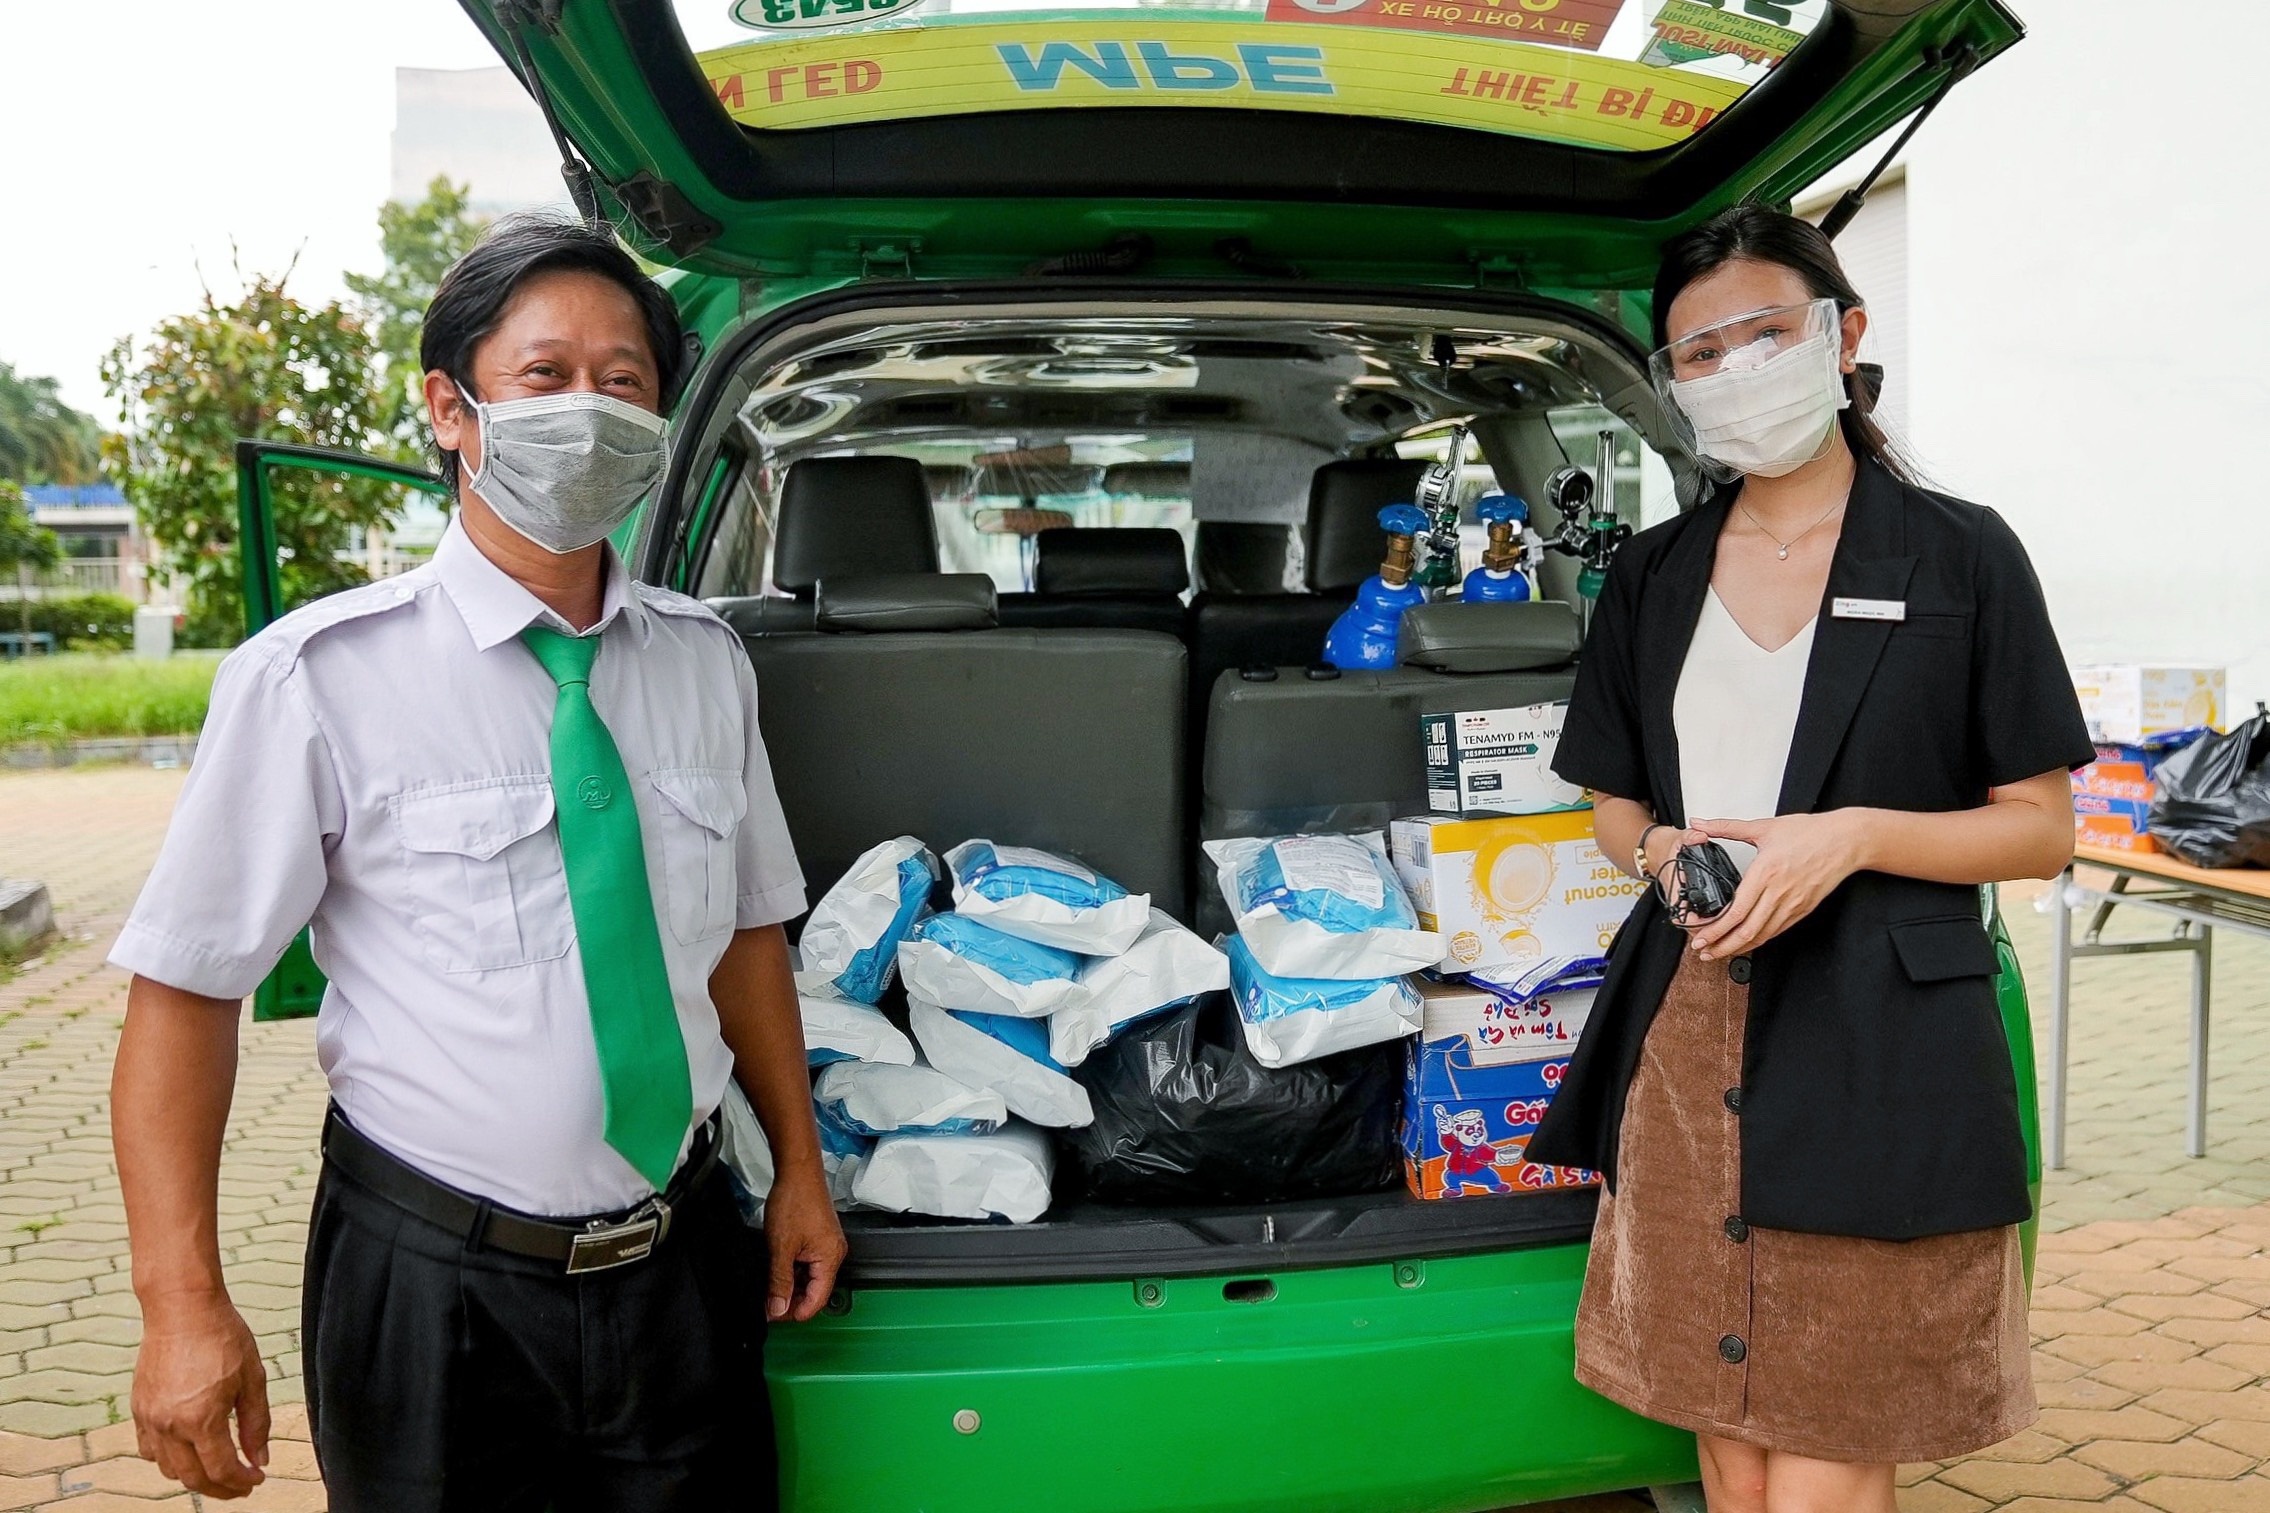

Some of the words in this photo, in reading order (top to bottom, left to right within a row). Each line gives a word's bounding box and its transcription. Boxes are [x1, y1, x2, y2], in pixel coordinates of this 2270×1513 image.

[1463, 732, 1515, 745] TENAMYD
[1518, 730, 1534, 741] FM
[1542, 729, 1561, 740] N95
[1464, 748, 1507, 758] RESPIRATOR
[1508, 746, 1528, 755] MASK
[1589, 867, 1630, 882] ater
[1564, 881, 1650, 905] Coconut
[1477, 1025, 1505, 1046] Gà
[1509, 1024, 1526, 1040] và
[1531, 1020, 1568, 1041] Tôm
[1519, 1163, 1556, 1189] Gà
